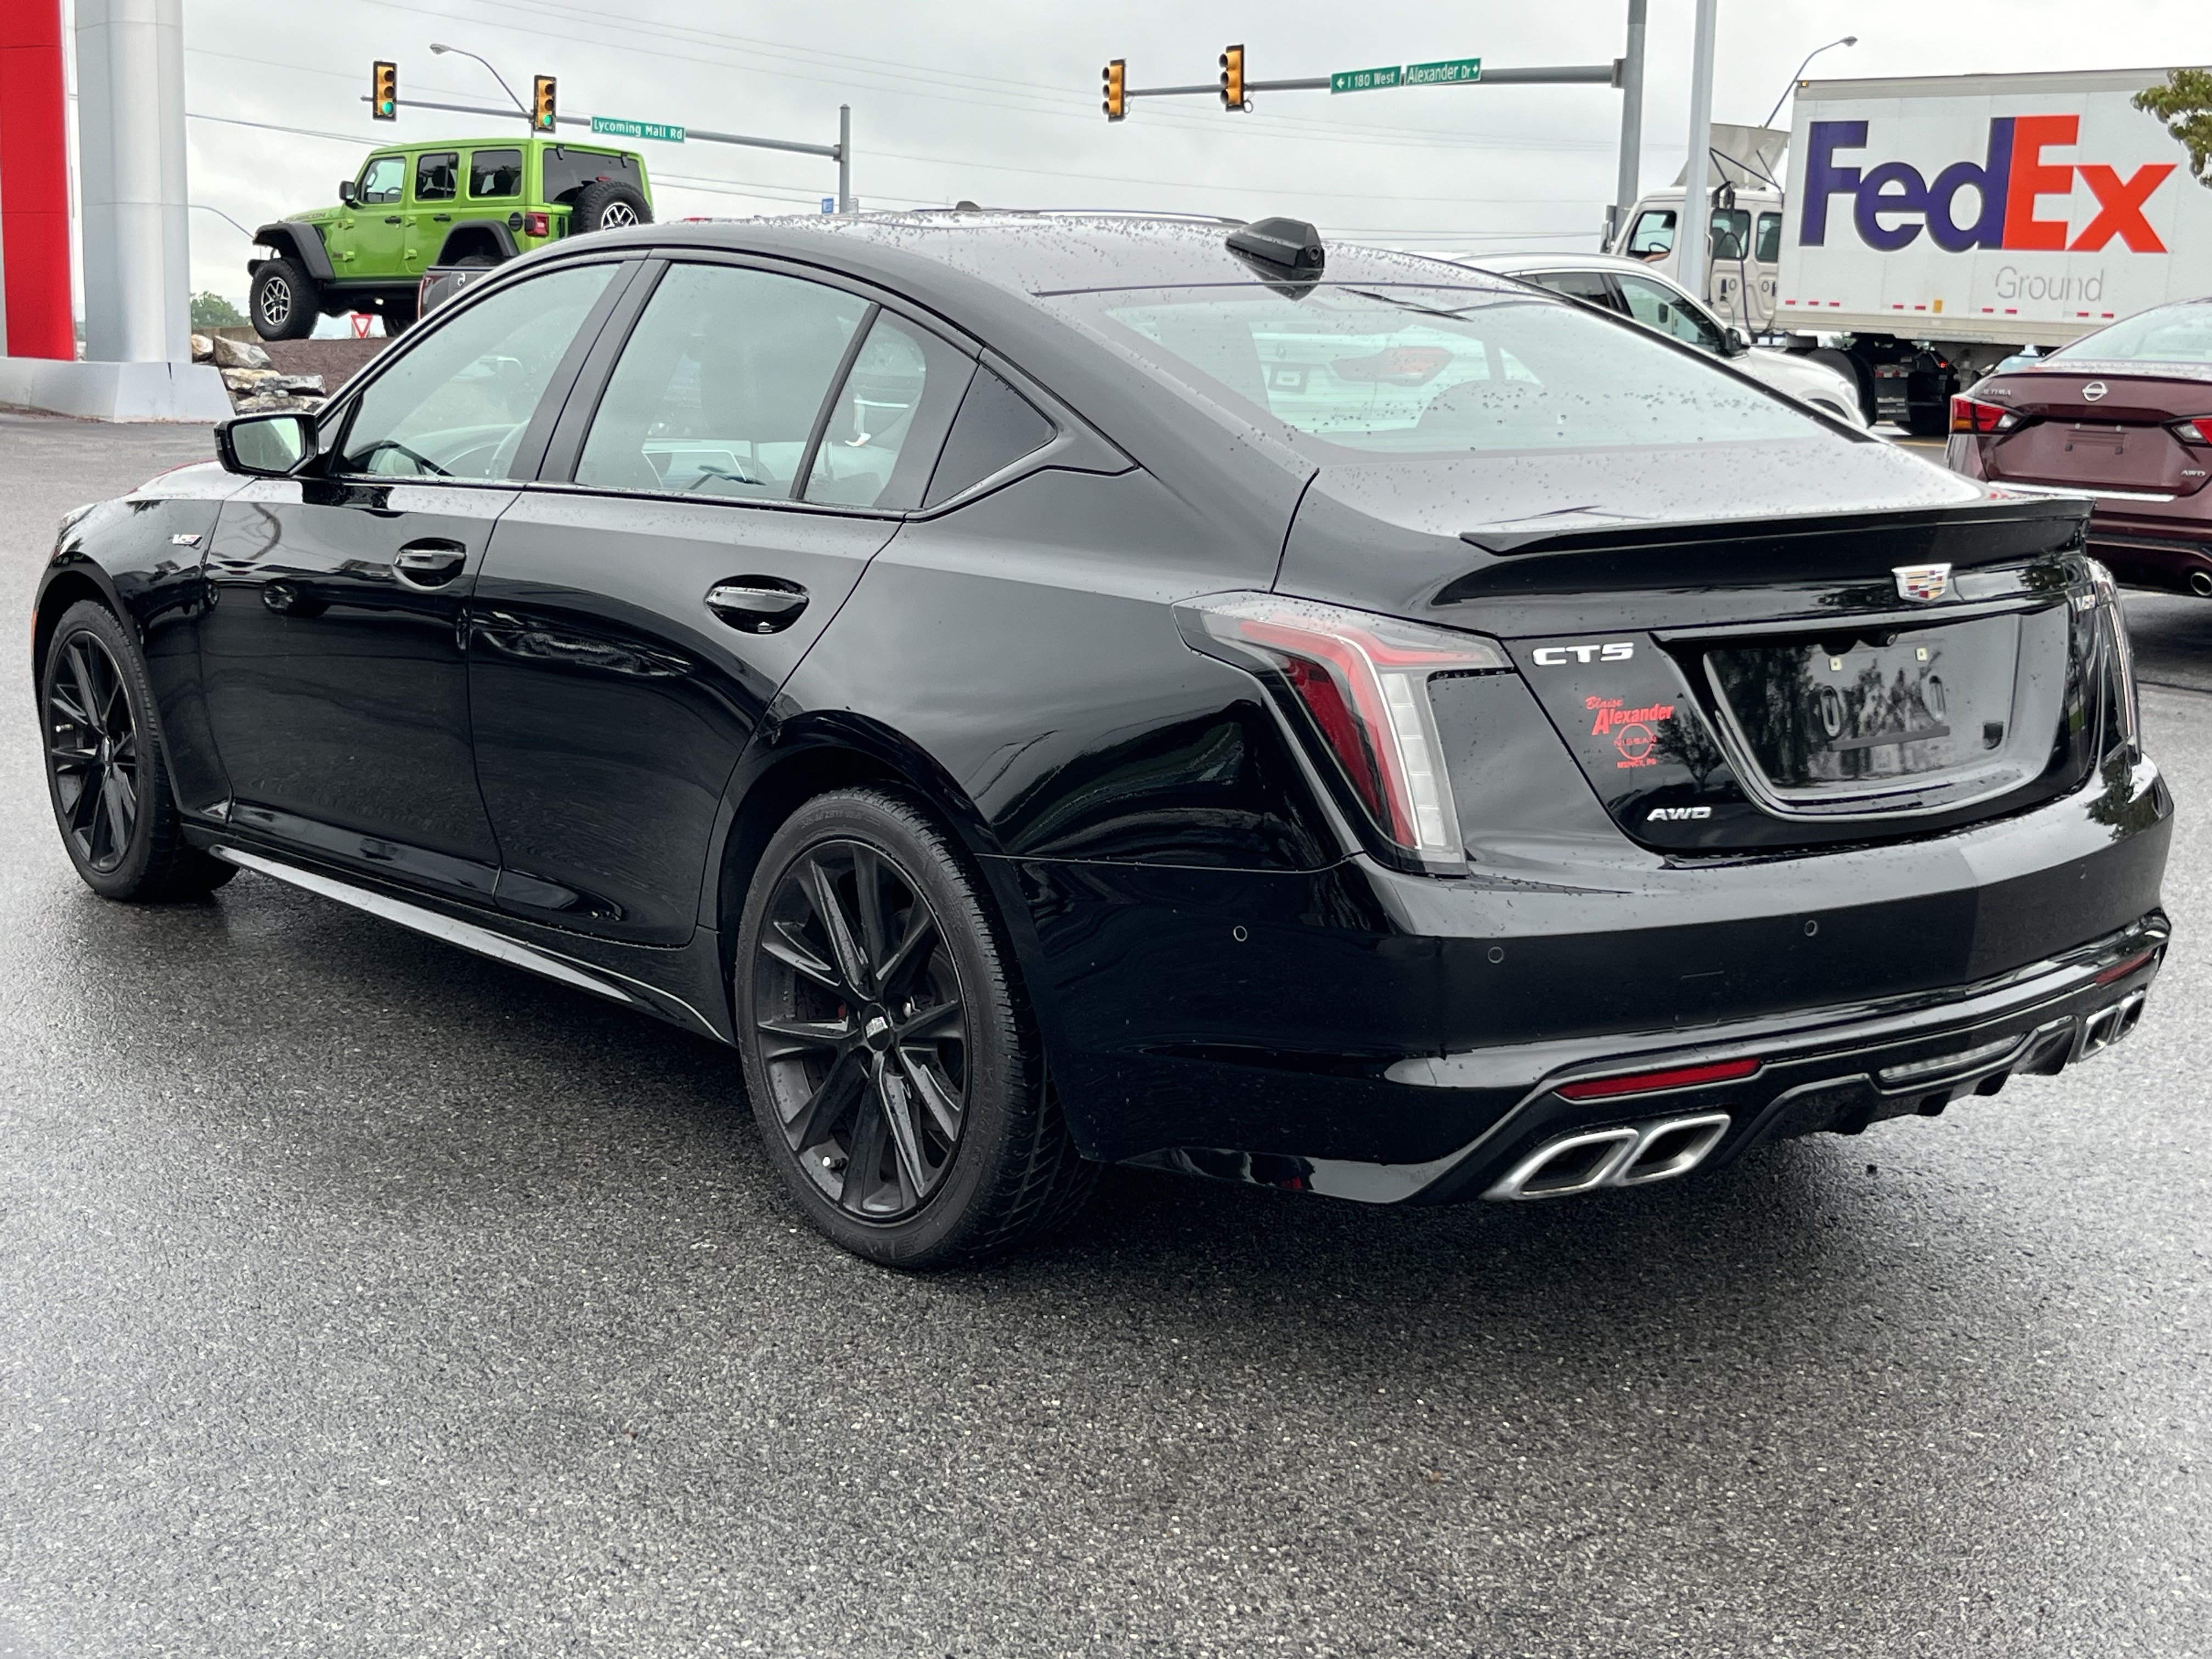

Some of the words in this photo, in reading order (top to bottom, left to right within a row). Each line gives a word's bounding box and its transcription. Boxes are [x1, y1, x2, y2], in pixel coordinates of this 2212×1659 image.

[1355, 74, 1370, 87] 180
[1374, 71, 1395, 85] West
[1406, 64, 1459, 83] Alexander
[1462, 65, 1471, 78] Dr
[594, 119, 642, 138] Lycoming
[645, 125, 666, 137] Mall
[670, 128, 683, 140] Rd
[1798, 114, 2178, 254] FedEx
[1995, 266, 2105, 302] Ground
[2181, 469, 2206, 477] AWD
[1585, 696, 1624, 710] Blaise
[1592, 703, 1675, 736] Alexander
[1613, 735, 1657, 747] NISSAN
[1646, 806, 1712, 822] AWD
